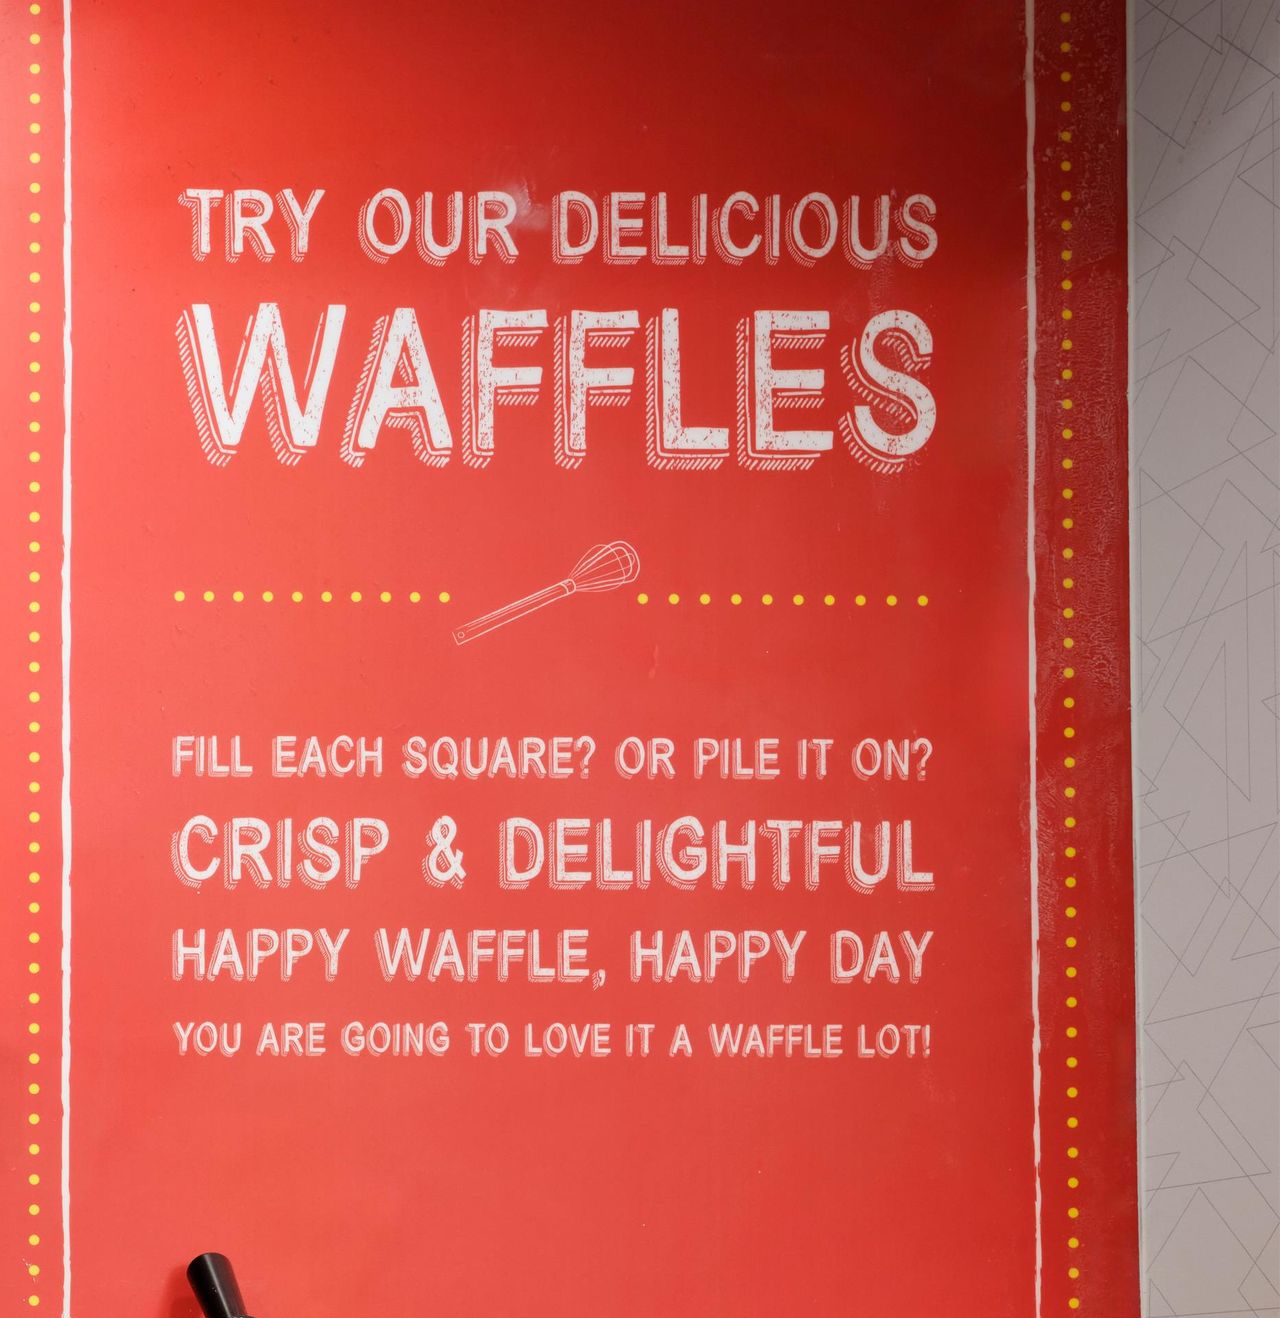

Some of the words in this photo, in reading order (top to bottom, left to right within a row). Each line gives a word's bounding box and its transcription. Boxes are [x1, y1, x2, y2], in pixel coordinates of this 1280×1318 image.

[178, 188, 325, 263] TRY
[358, 187, 520, 266] OUR
[552, 190, 939, 270] DELICIOUS
[175, 303, 937, 473] WAFFLES
[172, 735, 253, 777] FILL
[272, 735, 383, 778] EACH
[402, 735, 596, 780] SQUARE?
[615, 737, 675, 780] OR
[694, 738, 780, 780] PILE
[797, 738, 834, 780] IT
[852, 737, 933, 780] ON?
[170, 815, 389, 889] CRISP
[422, 815, 468, 889] &
[498, 815, 935, 894] DELIGHTFUL
[172, 928, 349, 982] HAPPY
[374, 928, 606, 990] WAFFLE,
[630, 930, 807, 983] HAPPY
[830, 930, 934, 984] DAY
[173, 1021, 241, 1056] YOU
[256, 1022, 326, 1056] ARE
[341, 1021, 450, 1057] GOING
[465, 1022, 509, 1057] TO
[524, 1022, 611, 1058] LOVE
[626, 1023, 655, 1058] IT
[669, 1023, 693, 1058] A
[709, 1023, 843, 1058] WAFFLE
[857, 1024, 931, 1058] LOT!
